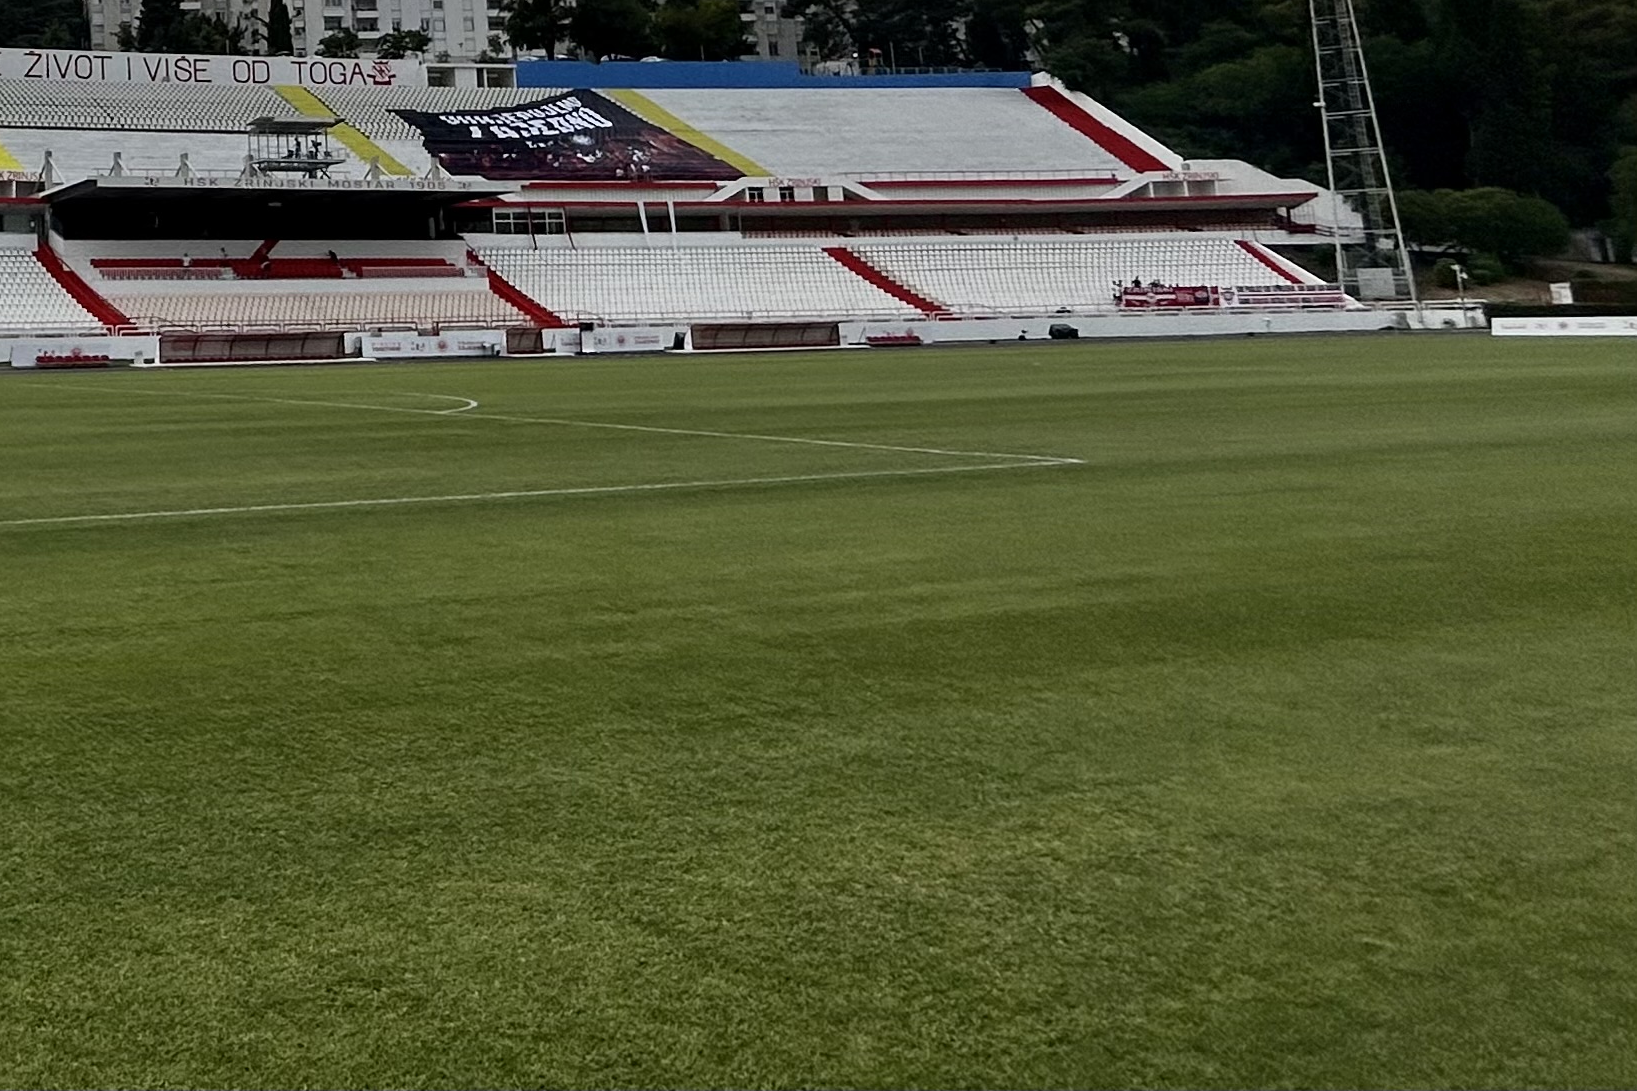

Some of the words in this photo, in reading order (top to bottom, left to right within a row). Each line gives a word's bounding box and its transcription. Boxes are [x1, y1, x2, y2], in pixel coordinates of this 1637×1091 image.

[23, 50, 113, 81] ŽIVOT
[126, 57, 132, 80] I
[143, 56, 213, 83] VIŠE
[232, 60, 270, 84] OD
[291, 61, 367, 86] TOGA
[234, 178, 315, 188] ZRINJSKI
[328, 180, 395, 189] MOSTAR
[410, 181, 446, 190] 1905
